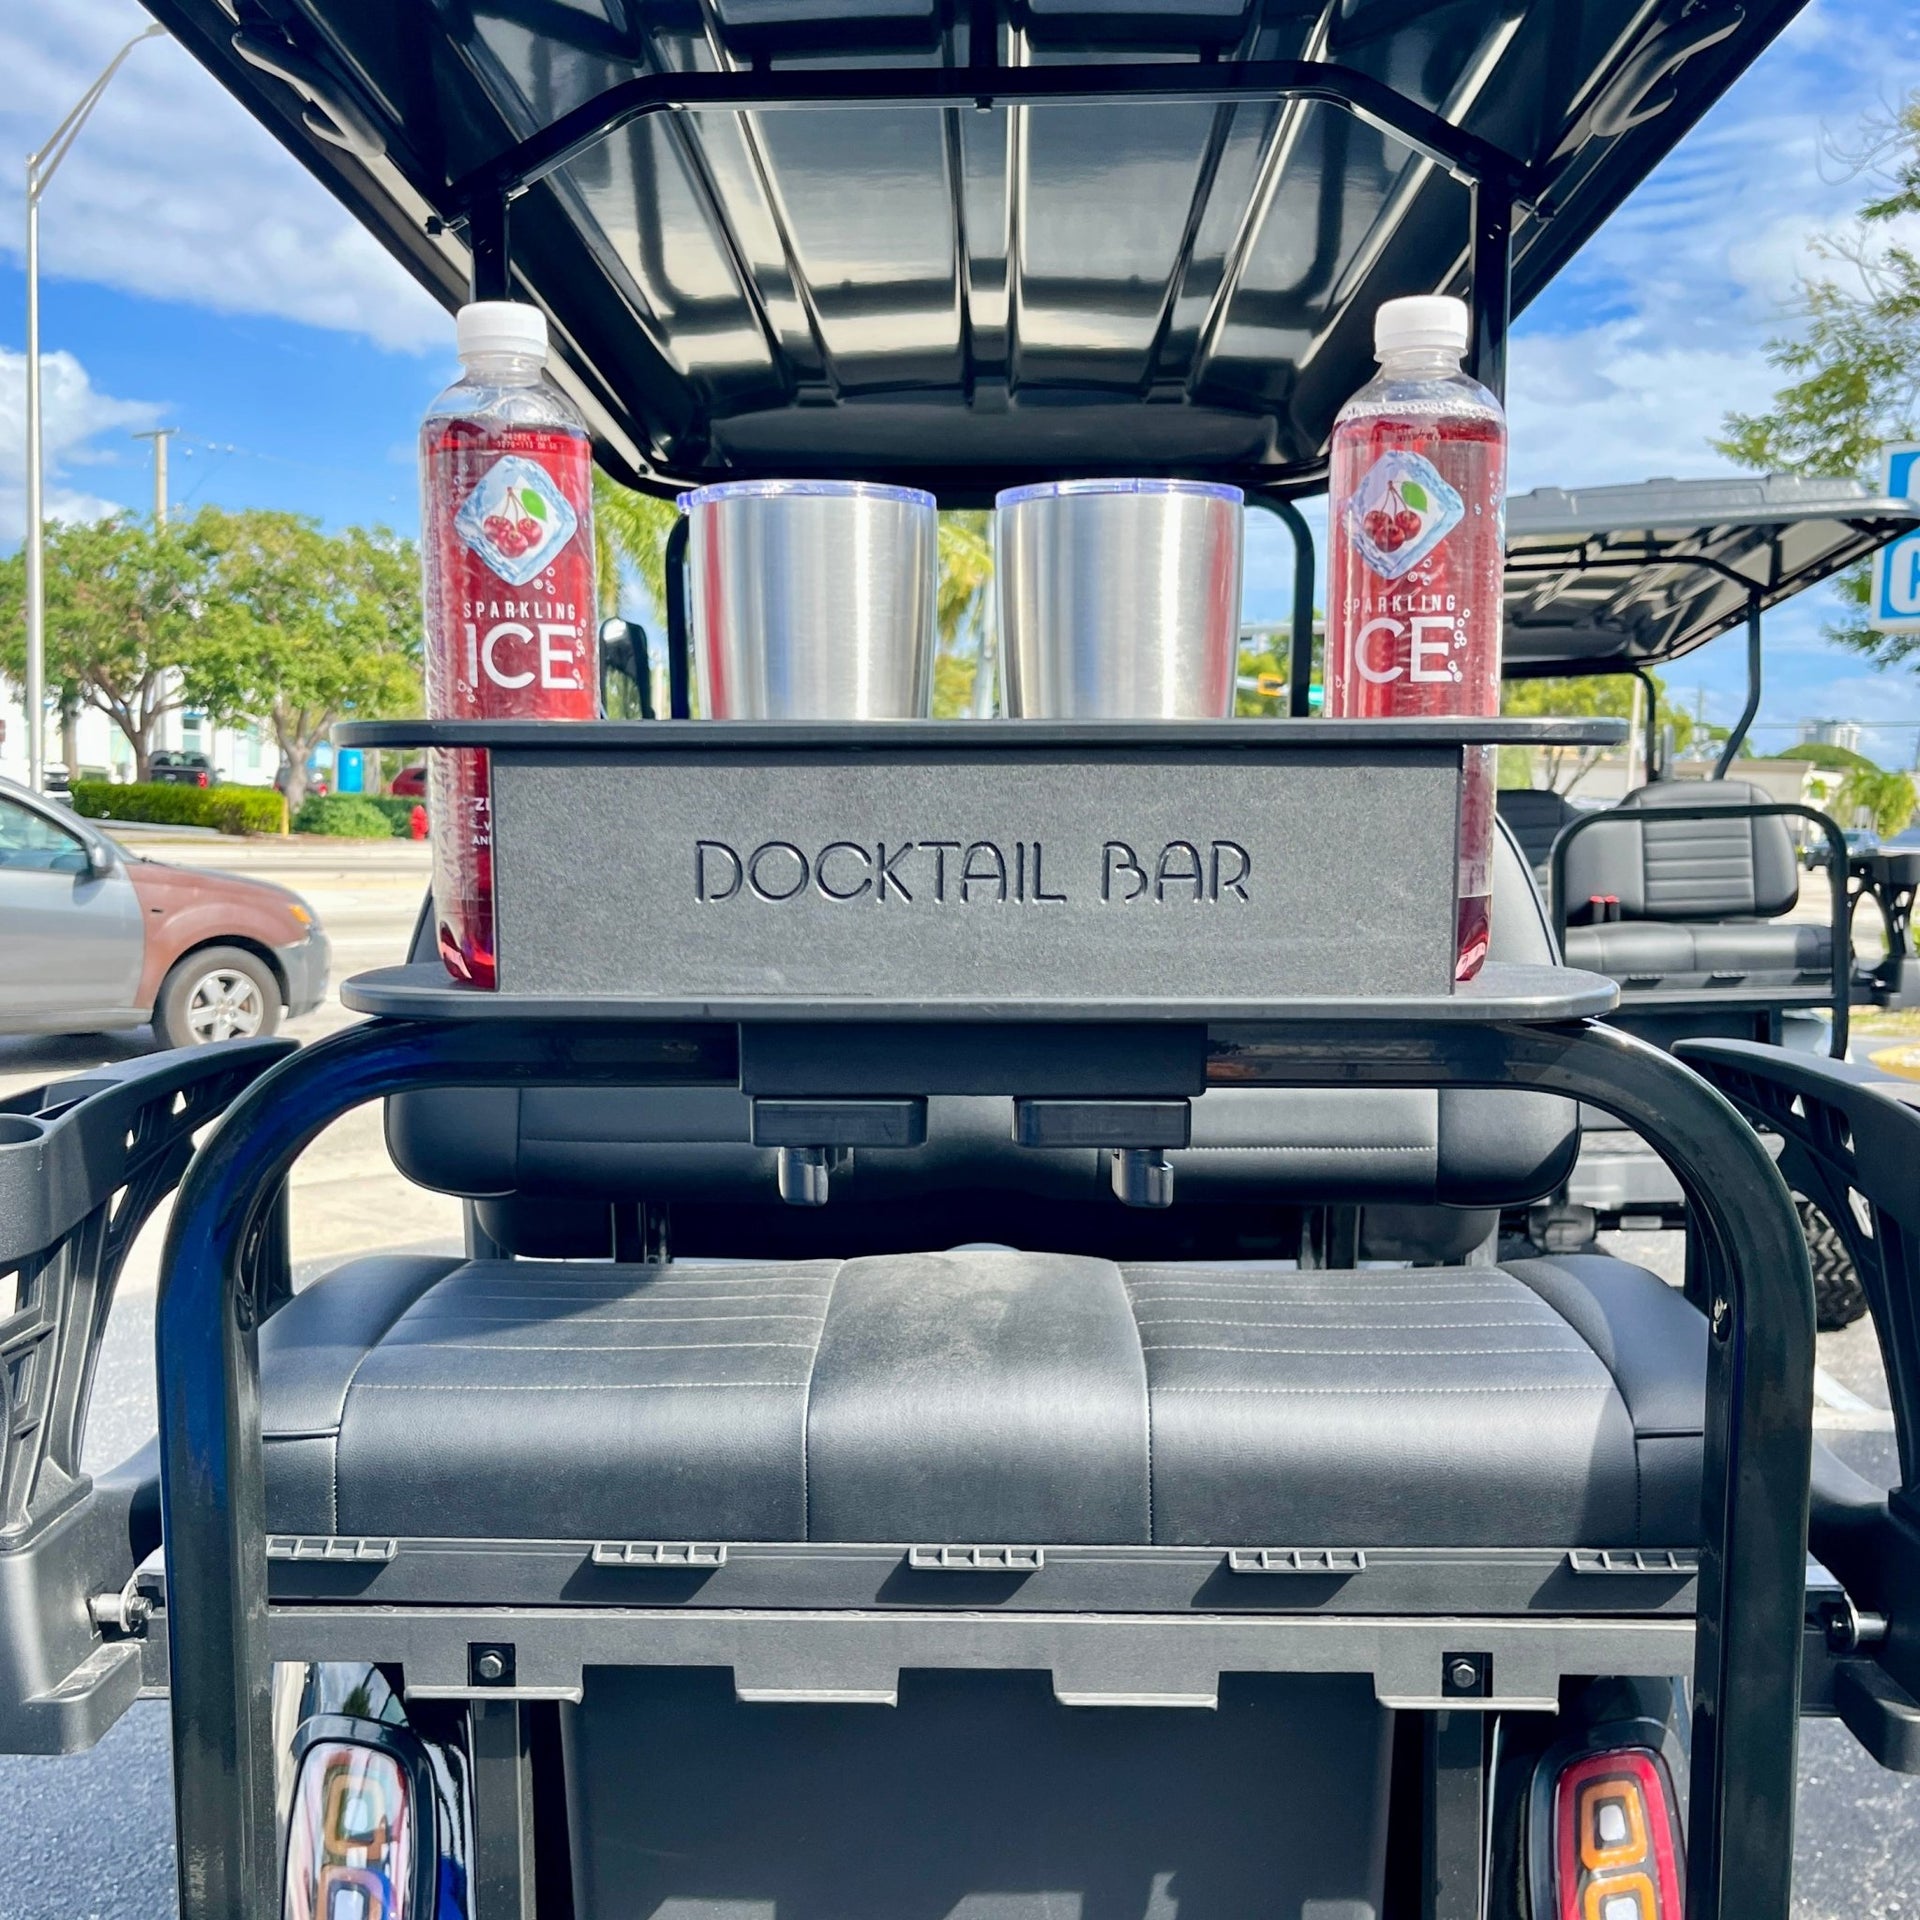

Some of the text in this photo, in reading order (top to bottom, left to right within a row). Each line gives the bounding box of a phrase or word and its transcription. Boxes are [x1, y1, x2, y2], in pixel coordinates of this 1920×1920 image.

[463, 600, 576, 620] SPARKLING
[1343, 594, 1456, 614] SPARKLING
[464, 622, 578, 689] ICE
[694, 840, 1251, 904] DOCKTAIL BAR
